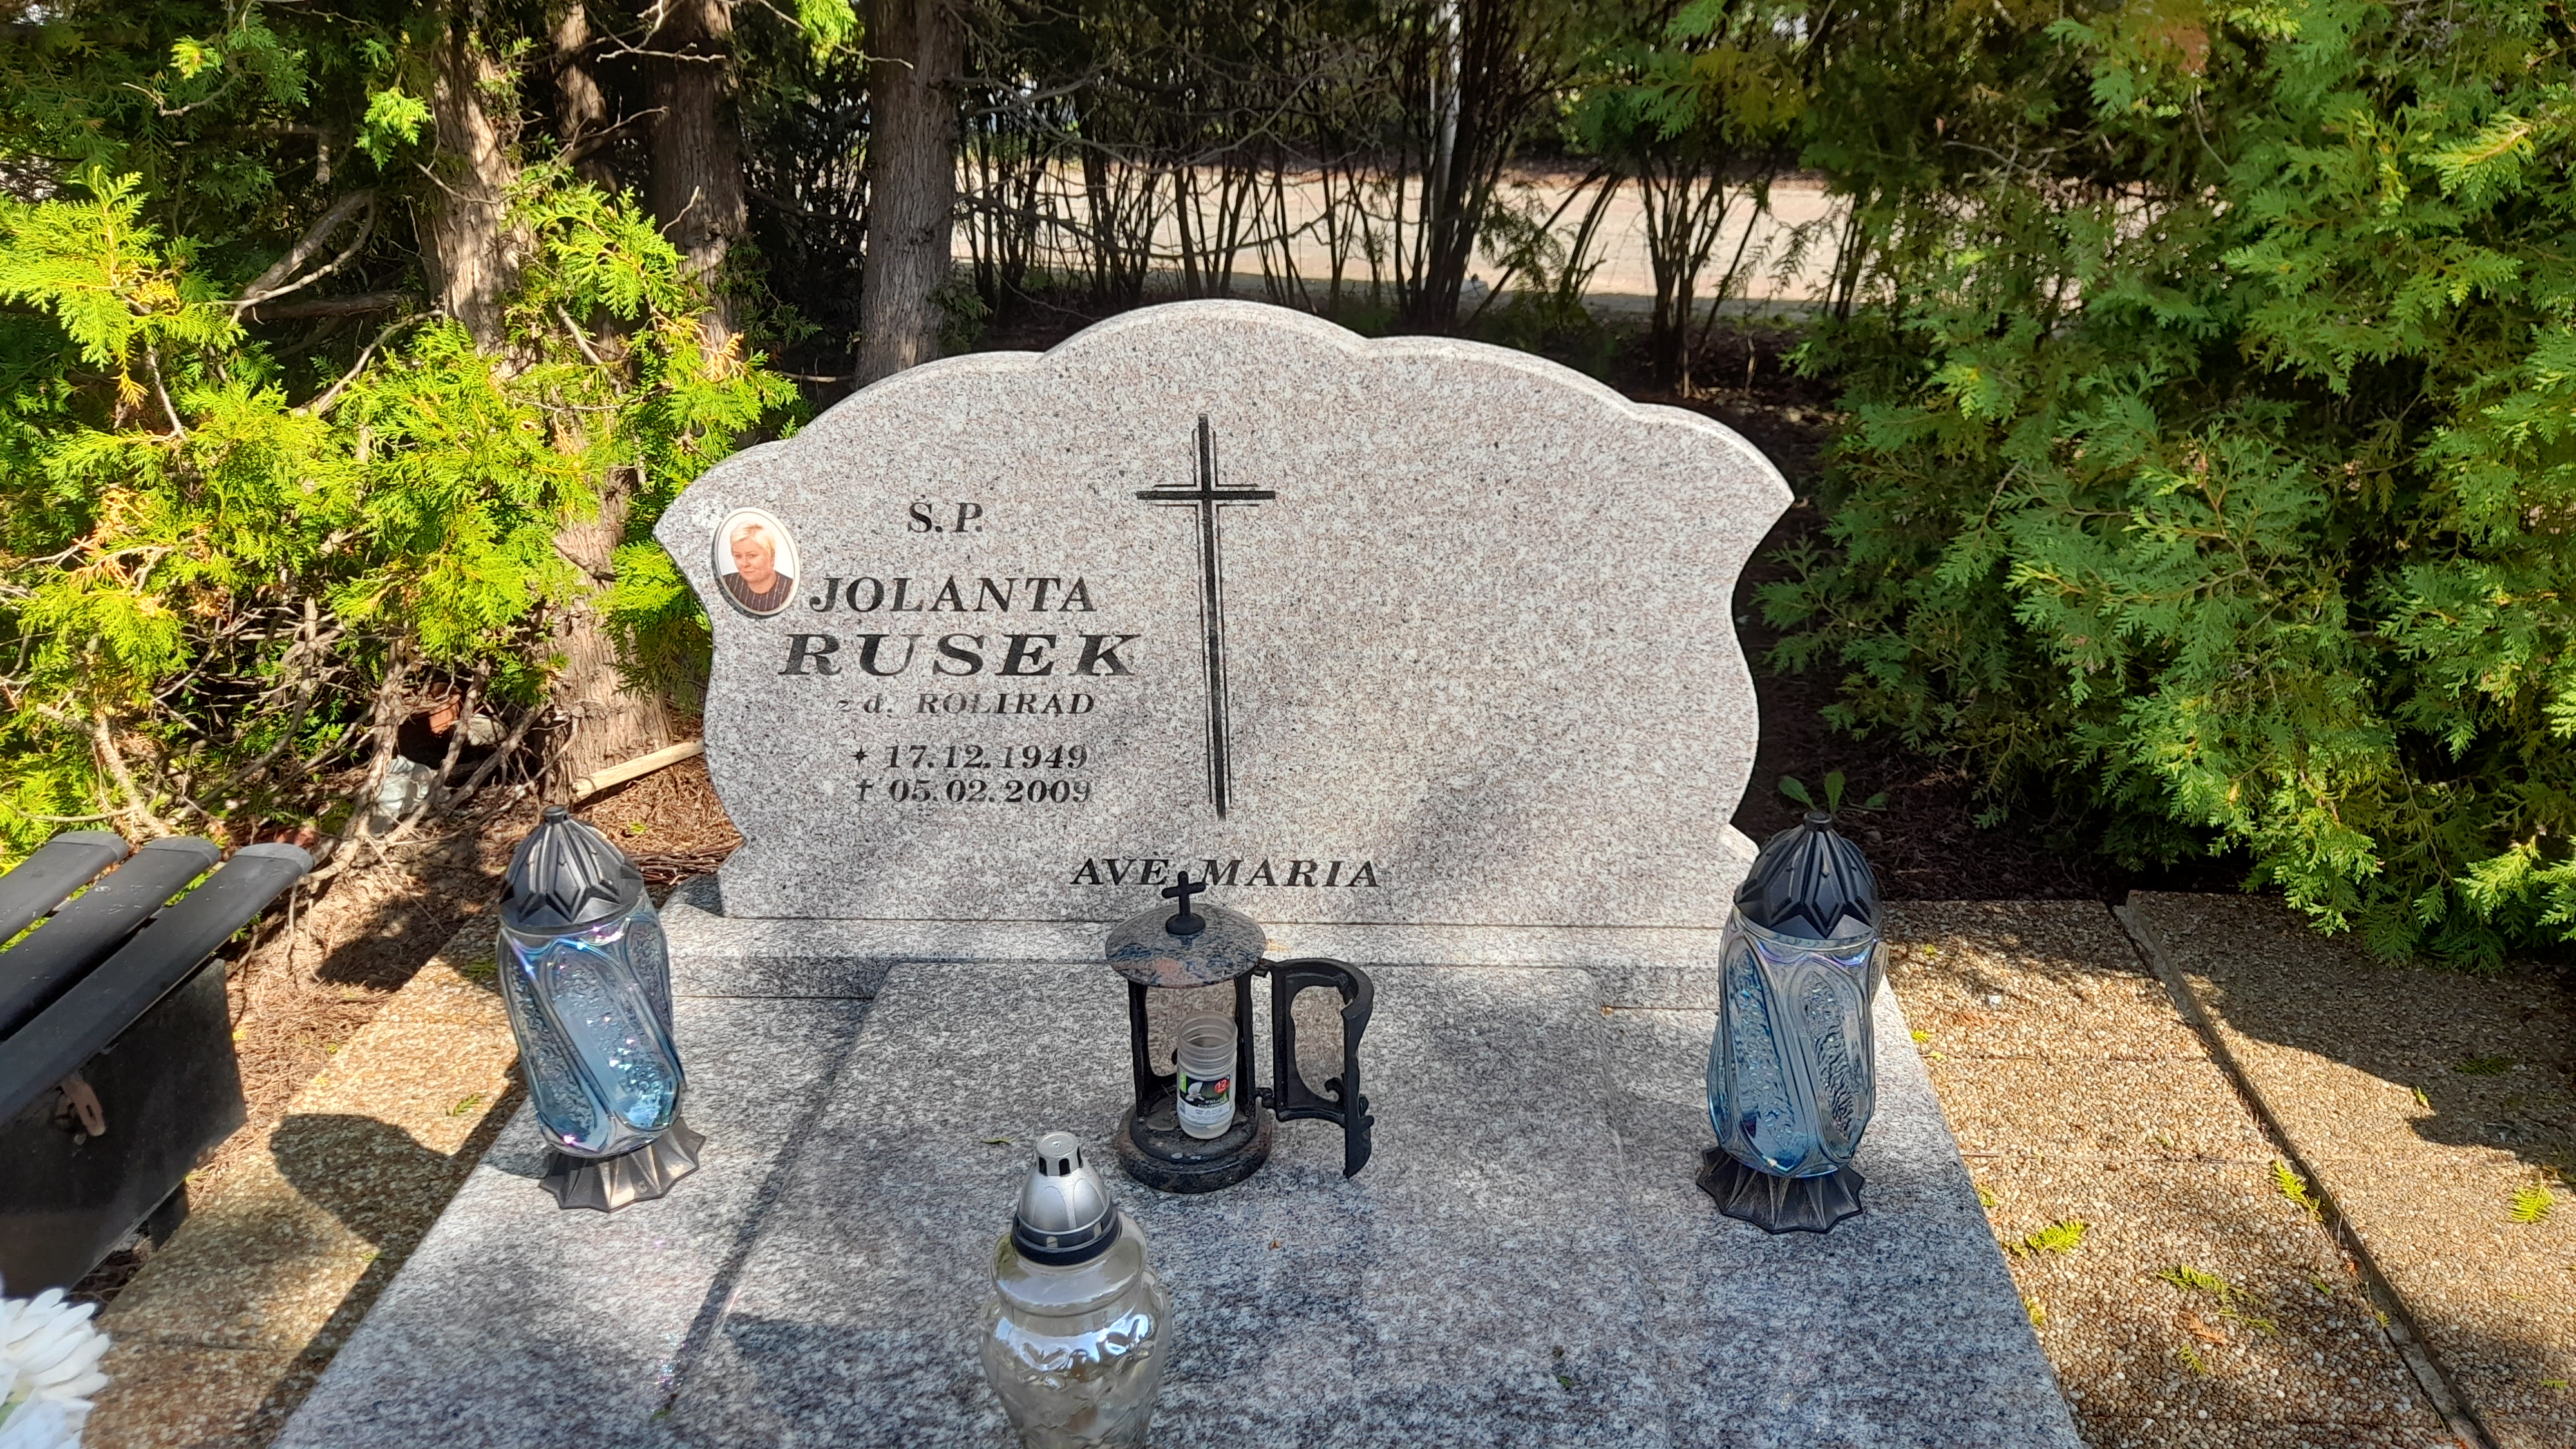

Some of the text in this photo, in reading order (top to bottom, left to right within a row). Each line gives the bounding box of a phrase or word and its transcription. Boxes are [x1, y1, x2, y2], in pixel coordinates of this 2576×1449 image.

[809, 575, 1098, 613] JOLANTA
[778, 633, 1141, 677] RUSEK
[886, 744, 1088, 770] 17.12.1949
[889, 779, 1093, 804] 05.02.2009
[1070, 857, 1381, 888] AVE MARIA
